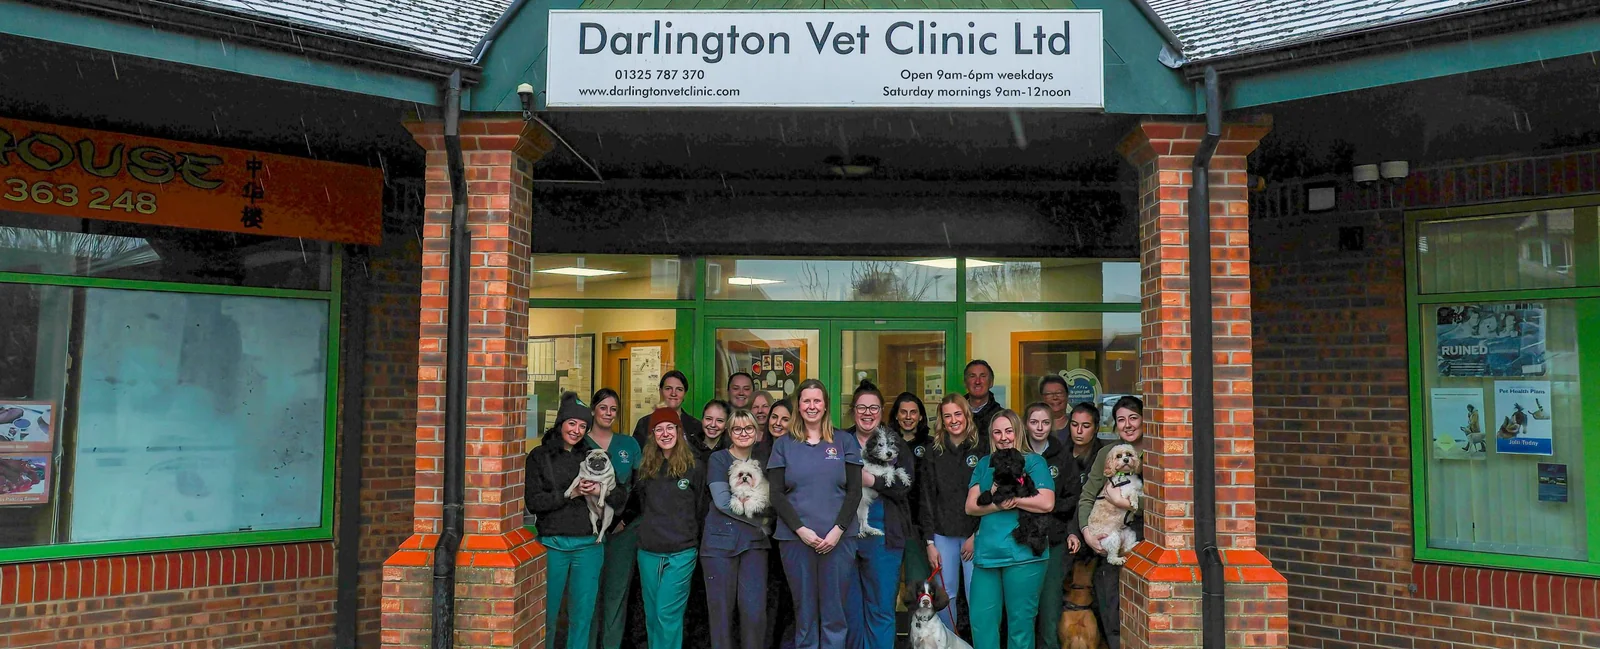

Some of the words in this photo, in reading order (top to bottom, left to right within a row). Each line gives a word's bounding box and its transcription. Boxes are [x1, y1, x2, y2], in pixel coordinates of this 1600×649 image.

[579, 20, 790, 64] Darlington
[805, 21, 870, 56] Vet
[884, 20, 997, 56] Clinic
[1014, 20, 1071, 56] Ltd
[614, 69, 652, 80] 01325
[656, 69, 679, 80] 787
[682, 69, 705, 80] 370
[900, 69, 933, 83] Open
[936, 69, 994, 83] 9am-6pm
[996, 69, 1054, 83] weekdays
[578, 85, 740, 99] www.darlingtonvetclinic.com
[882, 85, 935, 99] Saturday
[937, 85, 992, 100] mornings
[994, 85, 1071, 97] 9am-12noon
[3, 178, 79, 207] 363
[88, 187, 157, 215] 248
[1441, 345, 1488, 355] RUINED
